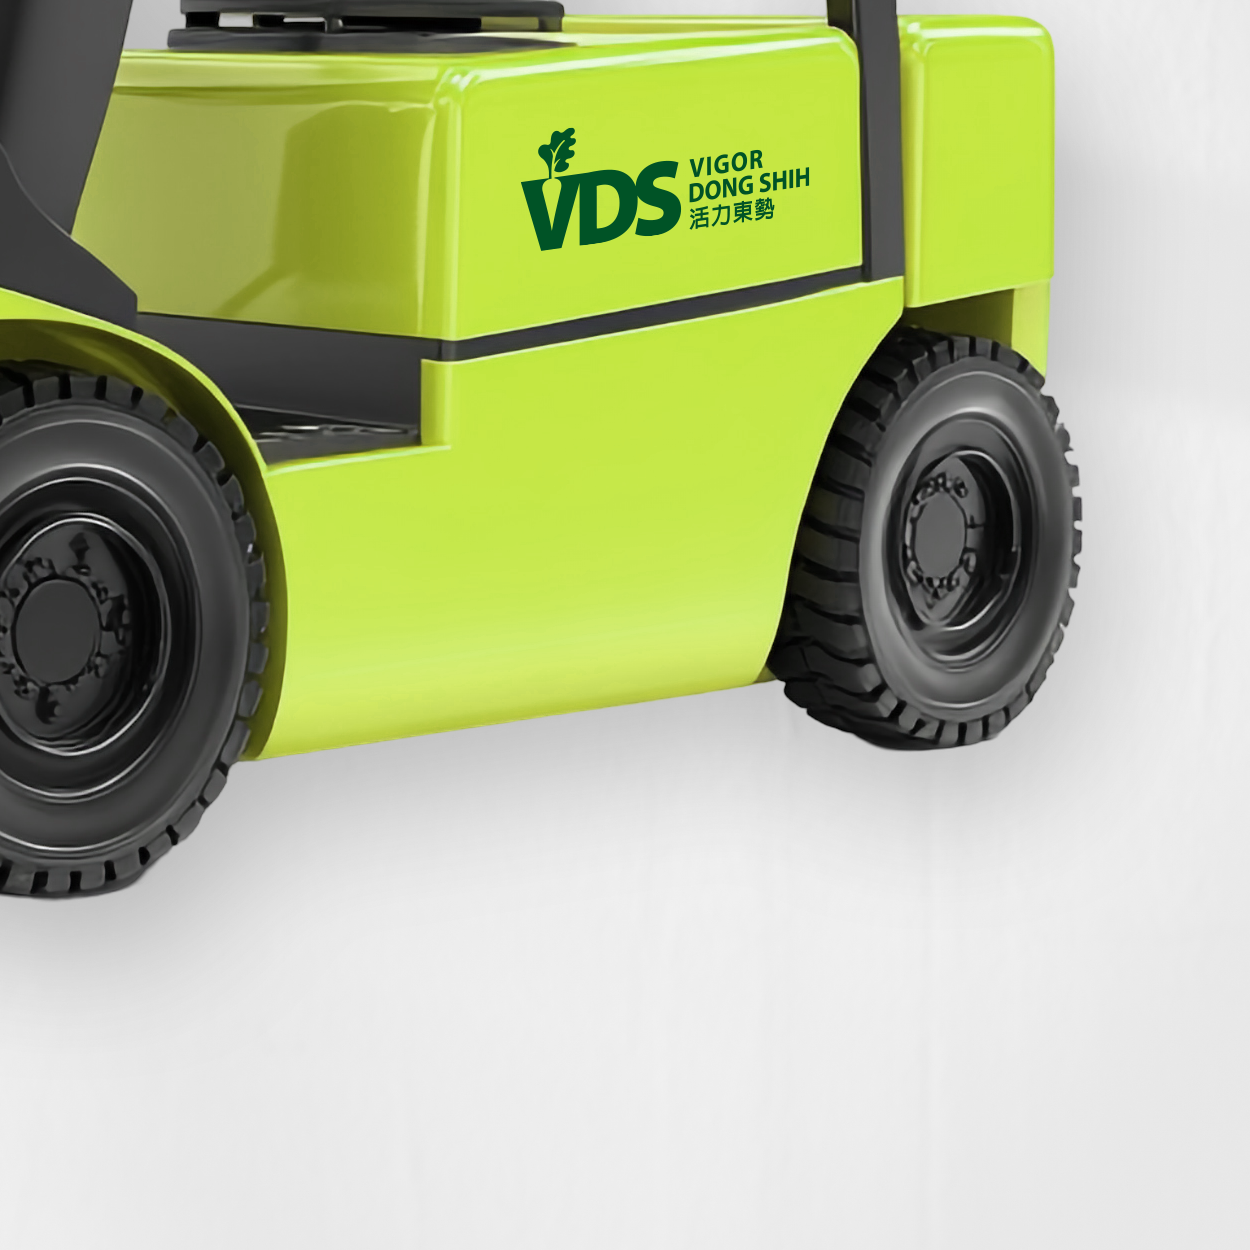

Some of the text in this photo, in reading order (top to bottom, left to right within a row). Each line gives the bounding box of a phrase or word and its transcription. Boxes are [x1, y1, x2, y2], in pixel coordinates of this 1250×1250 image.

[689, 149, 764, 178] VIGOR
[689, 166, 810, 203] DONG SHIH
[521, 160, 682, 252] VDS
[689, 196, 775, 231] 活力東勢
